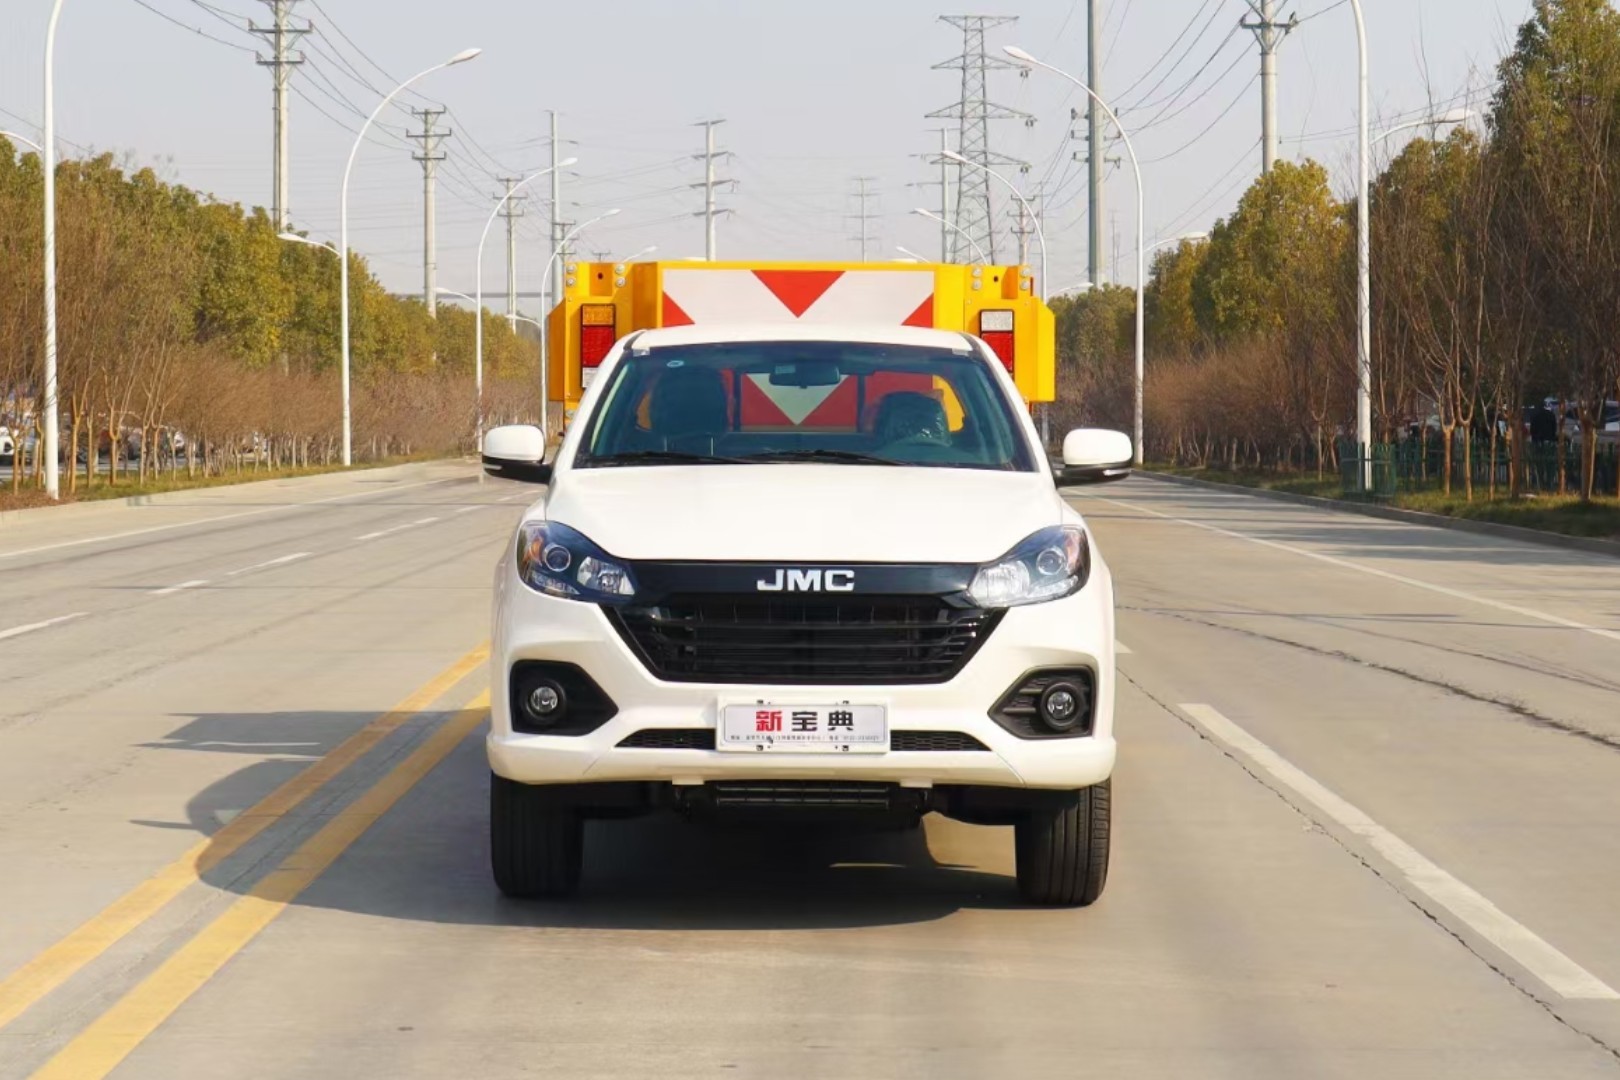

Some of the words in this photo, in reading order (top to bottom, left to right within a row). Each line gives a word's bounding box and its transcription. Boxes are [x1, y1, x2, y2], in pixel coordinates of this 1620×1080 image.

[757, 568, 855, 592] JMC
[756, 710, 854, 732] 新宝典
